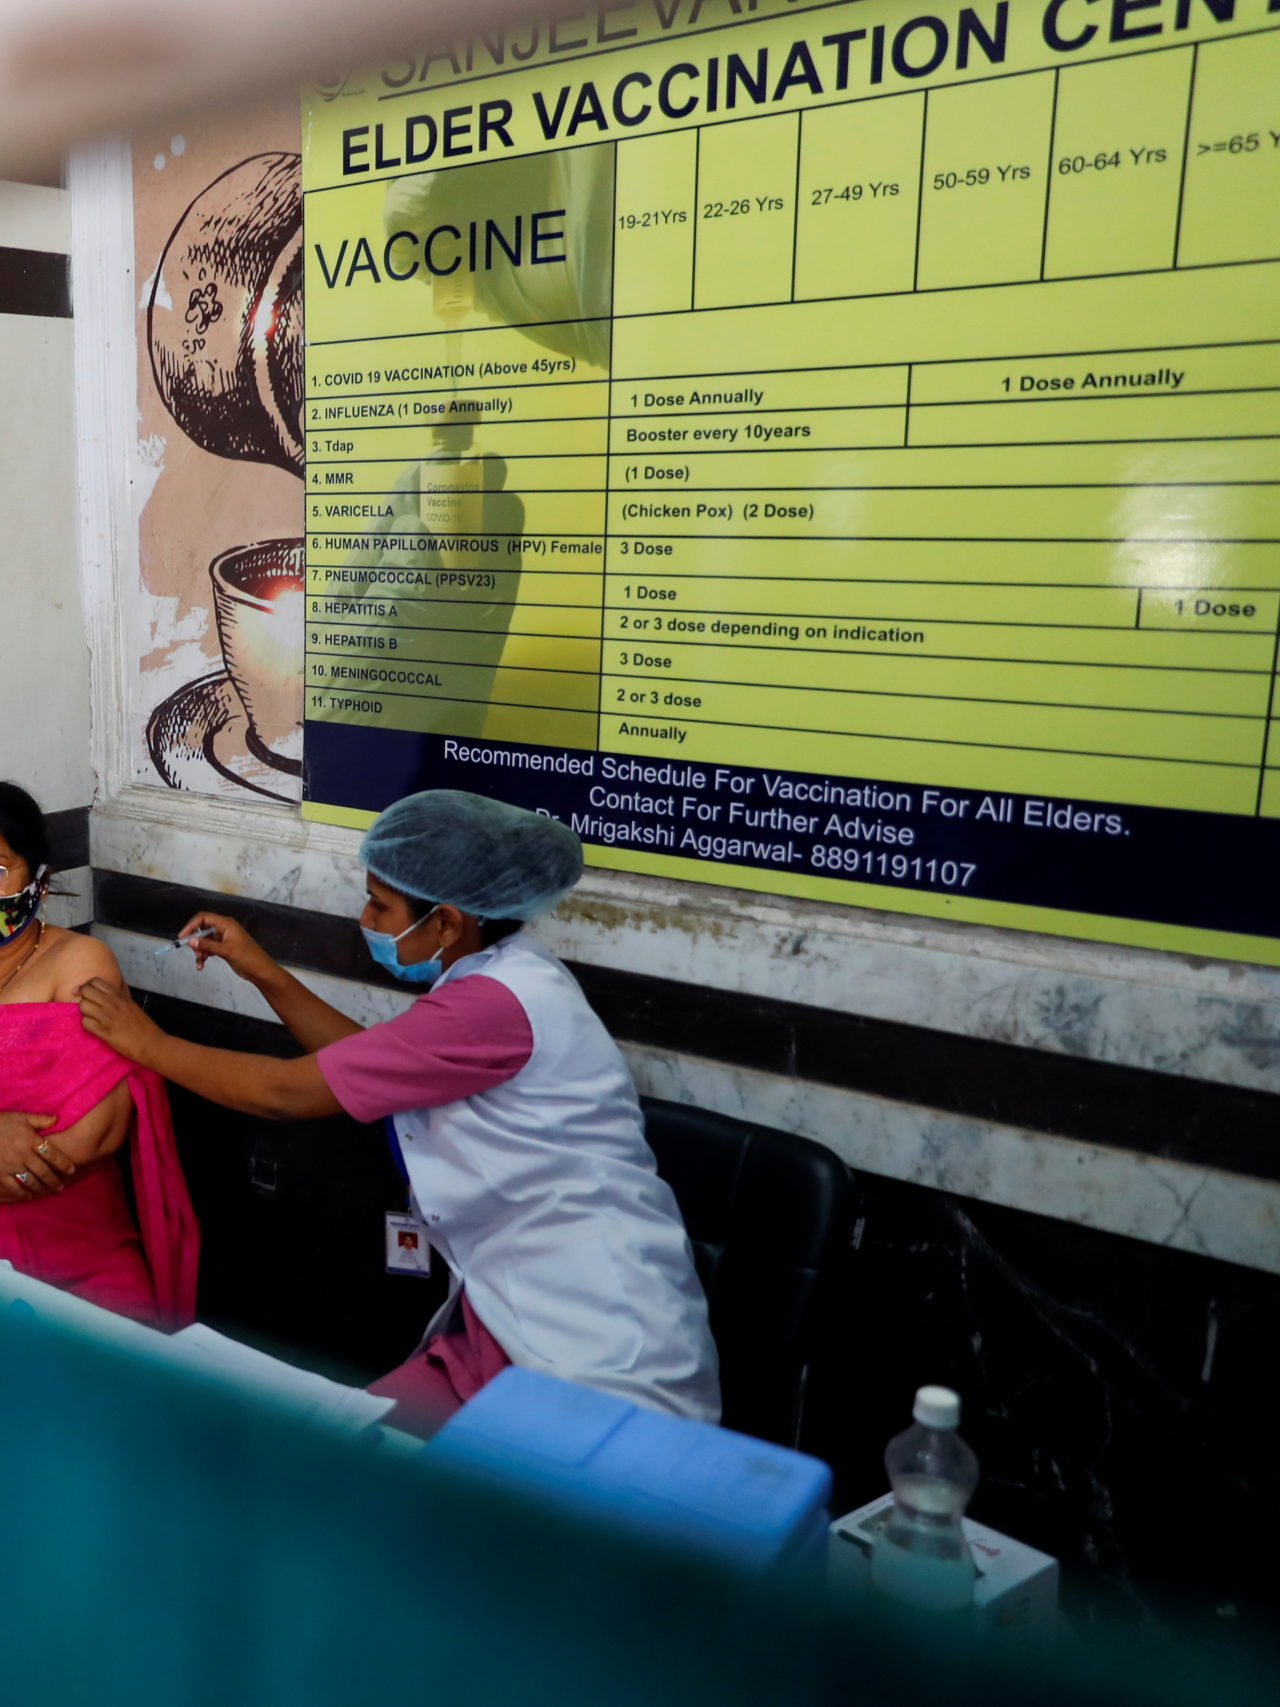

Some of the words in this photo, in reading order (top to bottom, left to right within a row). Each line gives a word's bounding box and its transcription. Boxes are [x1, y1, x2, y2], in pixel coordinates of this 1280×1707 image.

[342, 99, 515, 176] ELDER
[532, 1, 1010, 140] VACCINATION
[1196, 133, 1259, 157] >=65
[1058, 152, 1121, 175] 60-64
[1129, 146, 1167, 166] Yrs
[933, 168, 990, 190] 50-59
[997, 164, 1031, 182] Yrs
[811, 185, 863, 206] 27-49
[869, 181, 900, 200] Yrs
[703, 200, 750, 219] 22-26
[755, 196, 784, 213] Yrs
[315, 209, 567, 289] VACCINE
[312, 376, 321, 387] 1.
[325, 372, 363, 386] COVID
[367, 371, 381, 384] 19
[384, 364, 475, 383] VACCINATION
[479, 361, 528, 379] (Above
[531, 356, 577, 375] 45yrs)
[1001, 377, 1011, 392] 1
[1020, 376, 1075, 391] Dose
[1081, 368, 1185, 389] Annually
[631, 395, 638, 407] 1
[644, 393, 685, 407] Dose
[689, 389, 764, 406] Annually
[312, 409, 321, 420] 2.
[325, 404, 395, 419] INFLUENZA
[398, 403, 409, 419] (1
[413, 401, 446, 416] Dose
[449, 398, 513, 415] Annually)
[626, 427, 689, 443] Booster
[693, 427, 738, 443] every
[744, 424, 811, 442] 10years
[312, 441, 321, 452] 3.
[325, 440, 354, 455] Tdap
[312, 474, 321, 485] 4.
[325, 472, 354, 485] MMR
[625, 466, 638, 482] (1
[644, 466, 690, 482] Dose)
[312, 506, 321, 517] 5.
[325, 504, 394, 518] VARICELLA
[622, 504, 691, 521] (Chicken
[696, 503, 733, 521] Pox)
[743, 503, 758, 521] (2
[764, 503, 815, 521] Dose)
[312, 538, 321, 549] 6.
[325, 538, 370, 550] HUMAN
[373, 538, 499, 553] PAPILLOMAVIROUS
[507, 539, 547, 556] (HPV)
[550, 540, 602, 555] Female
[620, 541, 629, 555] 3
[634, 542, 673, 556] Dose
[312, 570, 321, 581] 7.
[325, 570, 432, 586] PNEUMOCOCCAL
[435, 573, 496, 590] (PPSV23)
[624, 586, 631, 599] 1
[637, 586, 677, 600] Dose
[312, 602, 321, 613] 8.
[325, 602, 386, 616] HEPATITIS
[388, 604, 398, 617] A
[1174, 600, 1184, 615] 1
[1195, 600, 1256, 617] Dose
[620, 616, 629, 629] 2
[633, 618, 650, 630] or
[653, 617, 662, 630] 3
[667, 618, 705, 633] dose
[710, 620, 799, 640] depending
[805, 626, 827, 639] on
[833, 625, 925, 643] indication
[312, 633, 321, 645] 9.
[325, 634, 385, 649] HEPATITIS
[389, 637, 398, 650] B
[620, 652, 629, 665] 3
[633, 653, 672, 668] Dose
[312, 664, 327, 677] 10.
[330, 666, 443, 686] MENINGOCOCCAL
[311, 696, 326, 709] 11.
[330, 697, 383, 714] TYPHOID
[617, 688, 626, 702] 2
[630, 691, 646, 704] or
[650, 690, 659, 704] 3
[663, 691, 702, 708] dose
[618, 722, 687, 744] Annually
[444, 740, 594, 777] Recommended
[601, 757, 707, 789] Schedule
[715, 769, 756, 795] For
[762, 774, 912, 812] Vaccination
[922, 790, 970, 818] For
[975, 796, 1013, 823] All
[1024, 800, 1131, 836] Elders.
[589, 786, 675, 816] Contact
[682, 797, 722, 822] For
[729, 802, 819, 834] Further
[823, 813, 914, 846] Advise
[571, 812, 675, 847] Mrigakshi
[680, 827, 803, 863] Aggarwal-
[810, 844, 977, 887] 8891191107
